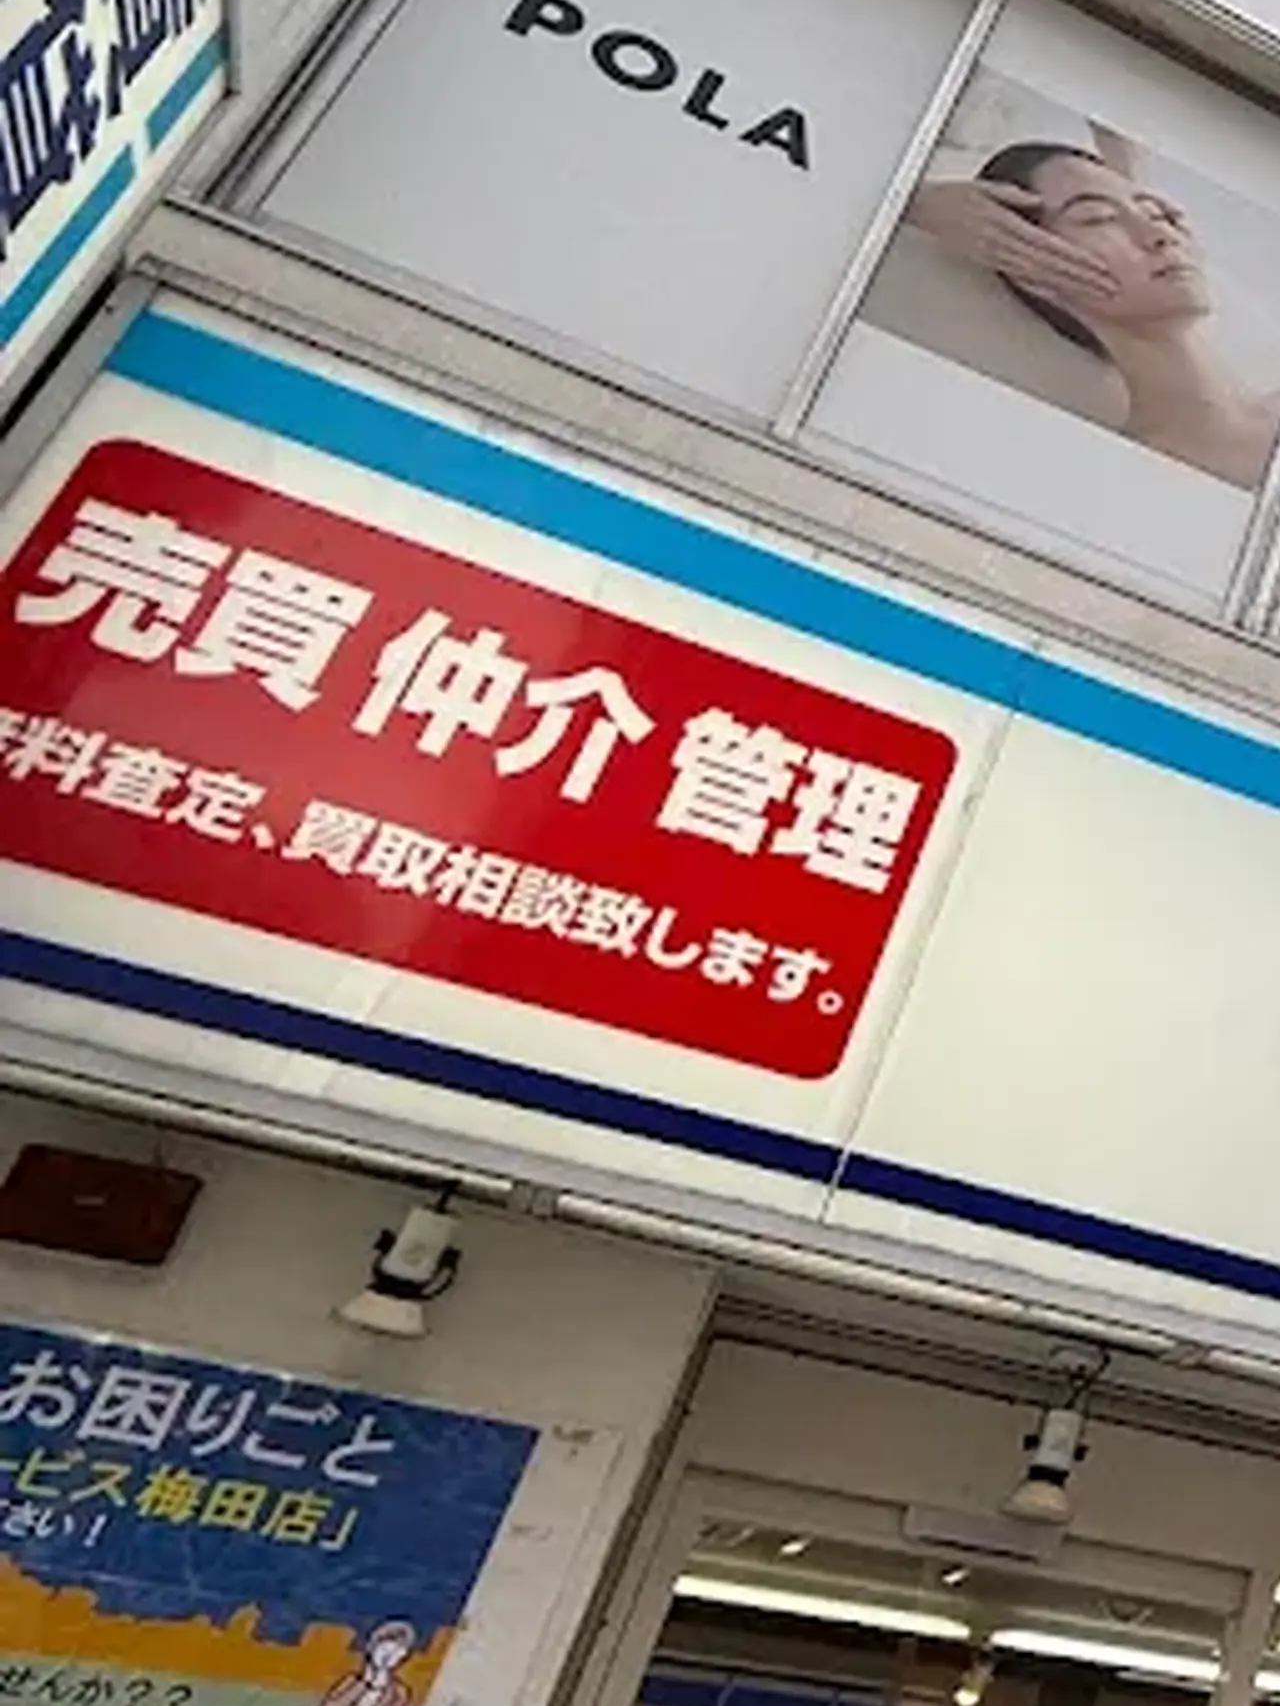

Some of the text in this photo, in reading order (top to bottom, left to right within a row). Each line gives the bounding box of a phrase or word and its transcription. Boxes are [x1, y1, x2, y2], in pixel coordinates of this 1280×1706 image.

[16, 496, 923, 894] 売買 仲介 管理
[0, 1350, 396, 1487] お困りごと
